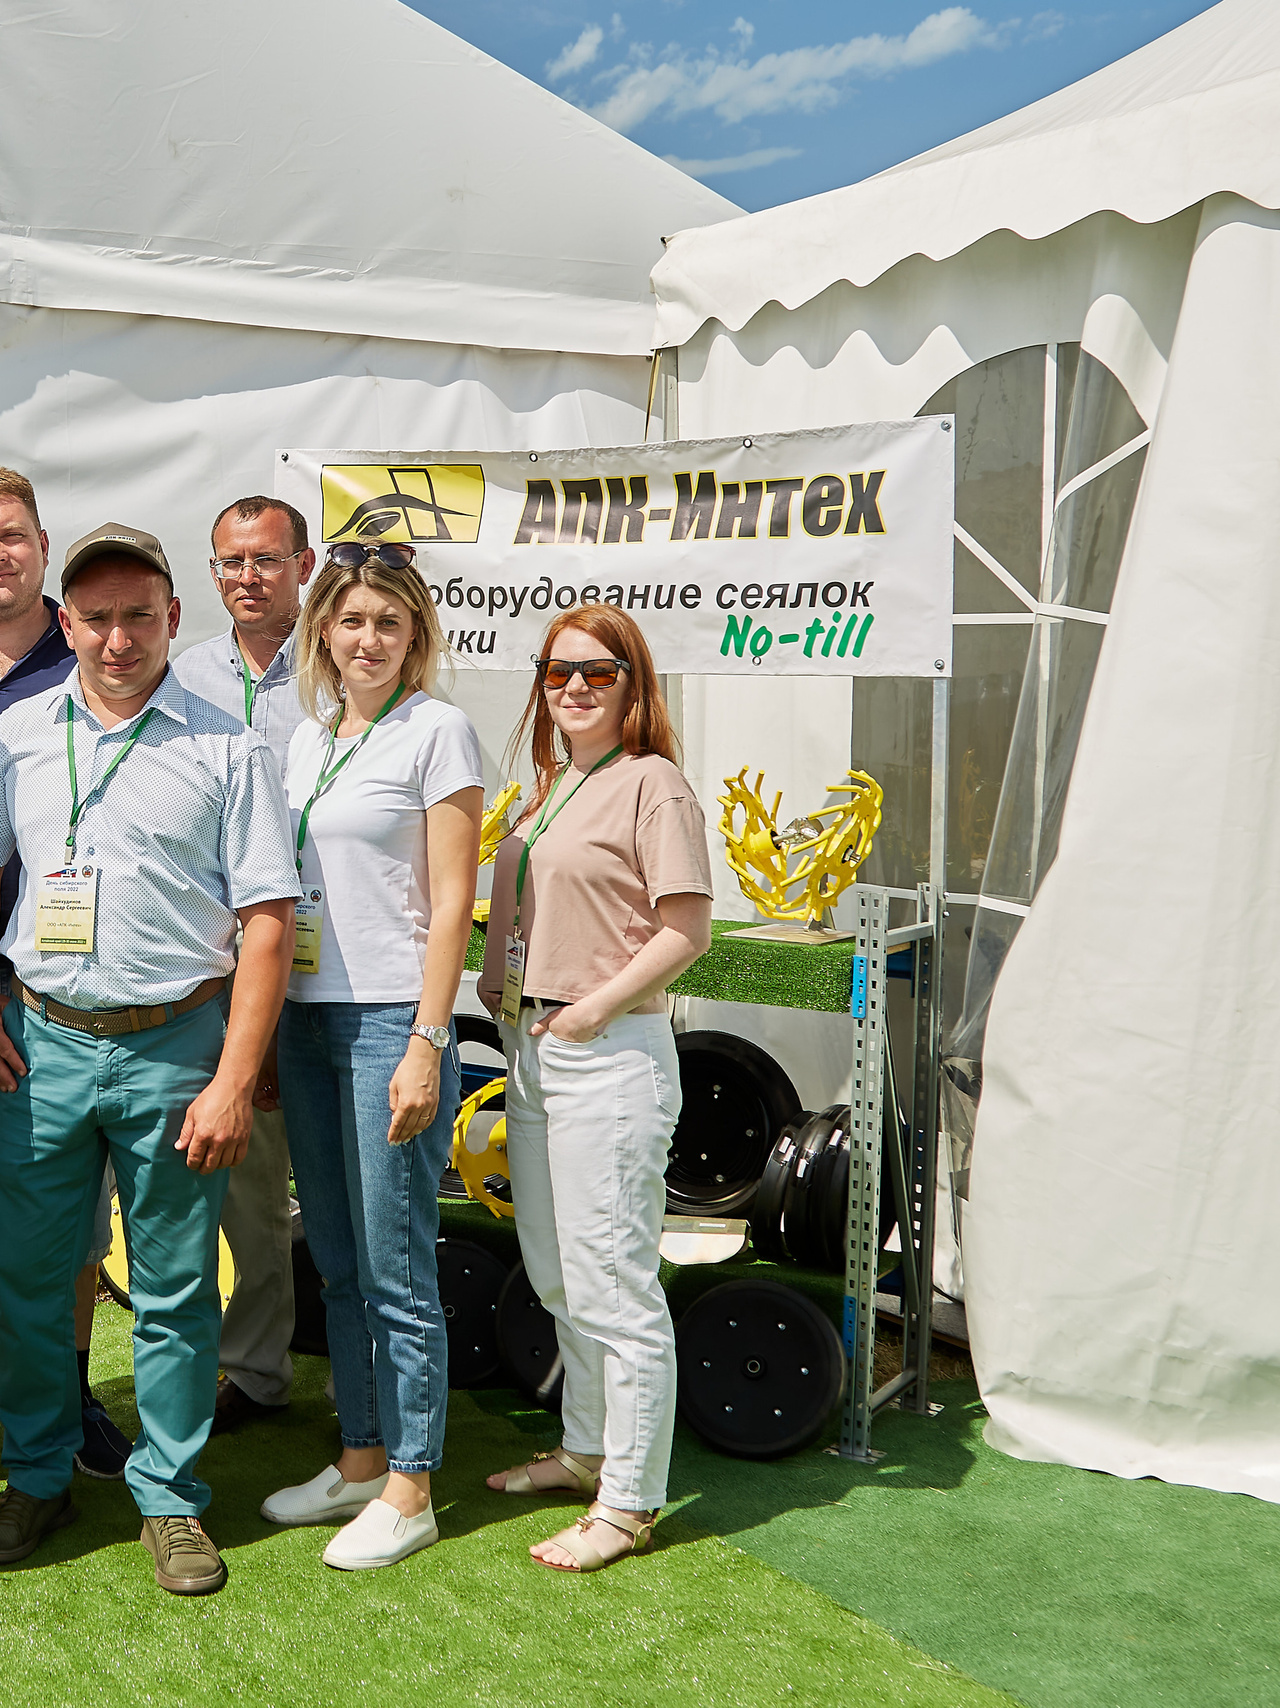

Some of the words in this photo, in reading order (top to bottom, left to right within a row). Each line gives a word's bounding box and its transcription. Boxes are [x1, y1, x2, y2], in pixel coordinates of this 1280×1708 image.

[512, 470, 888, 546] АПК-Интех
[427, 576, 702, 618] оборудование
[715, 580, 875, 610] сеялок
[720, 610, 875, 658] No-till
